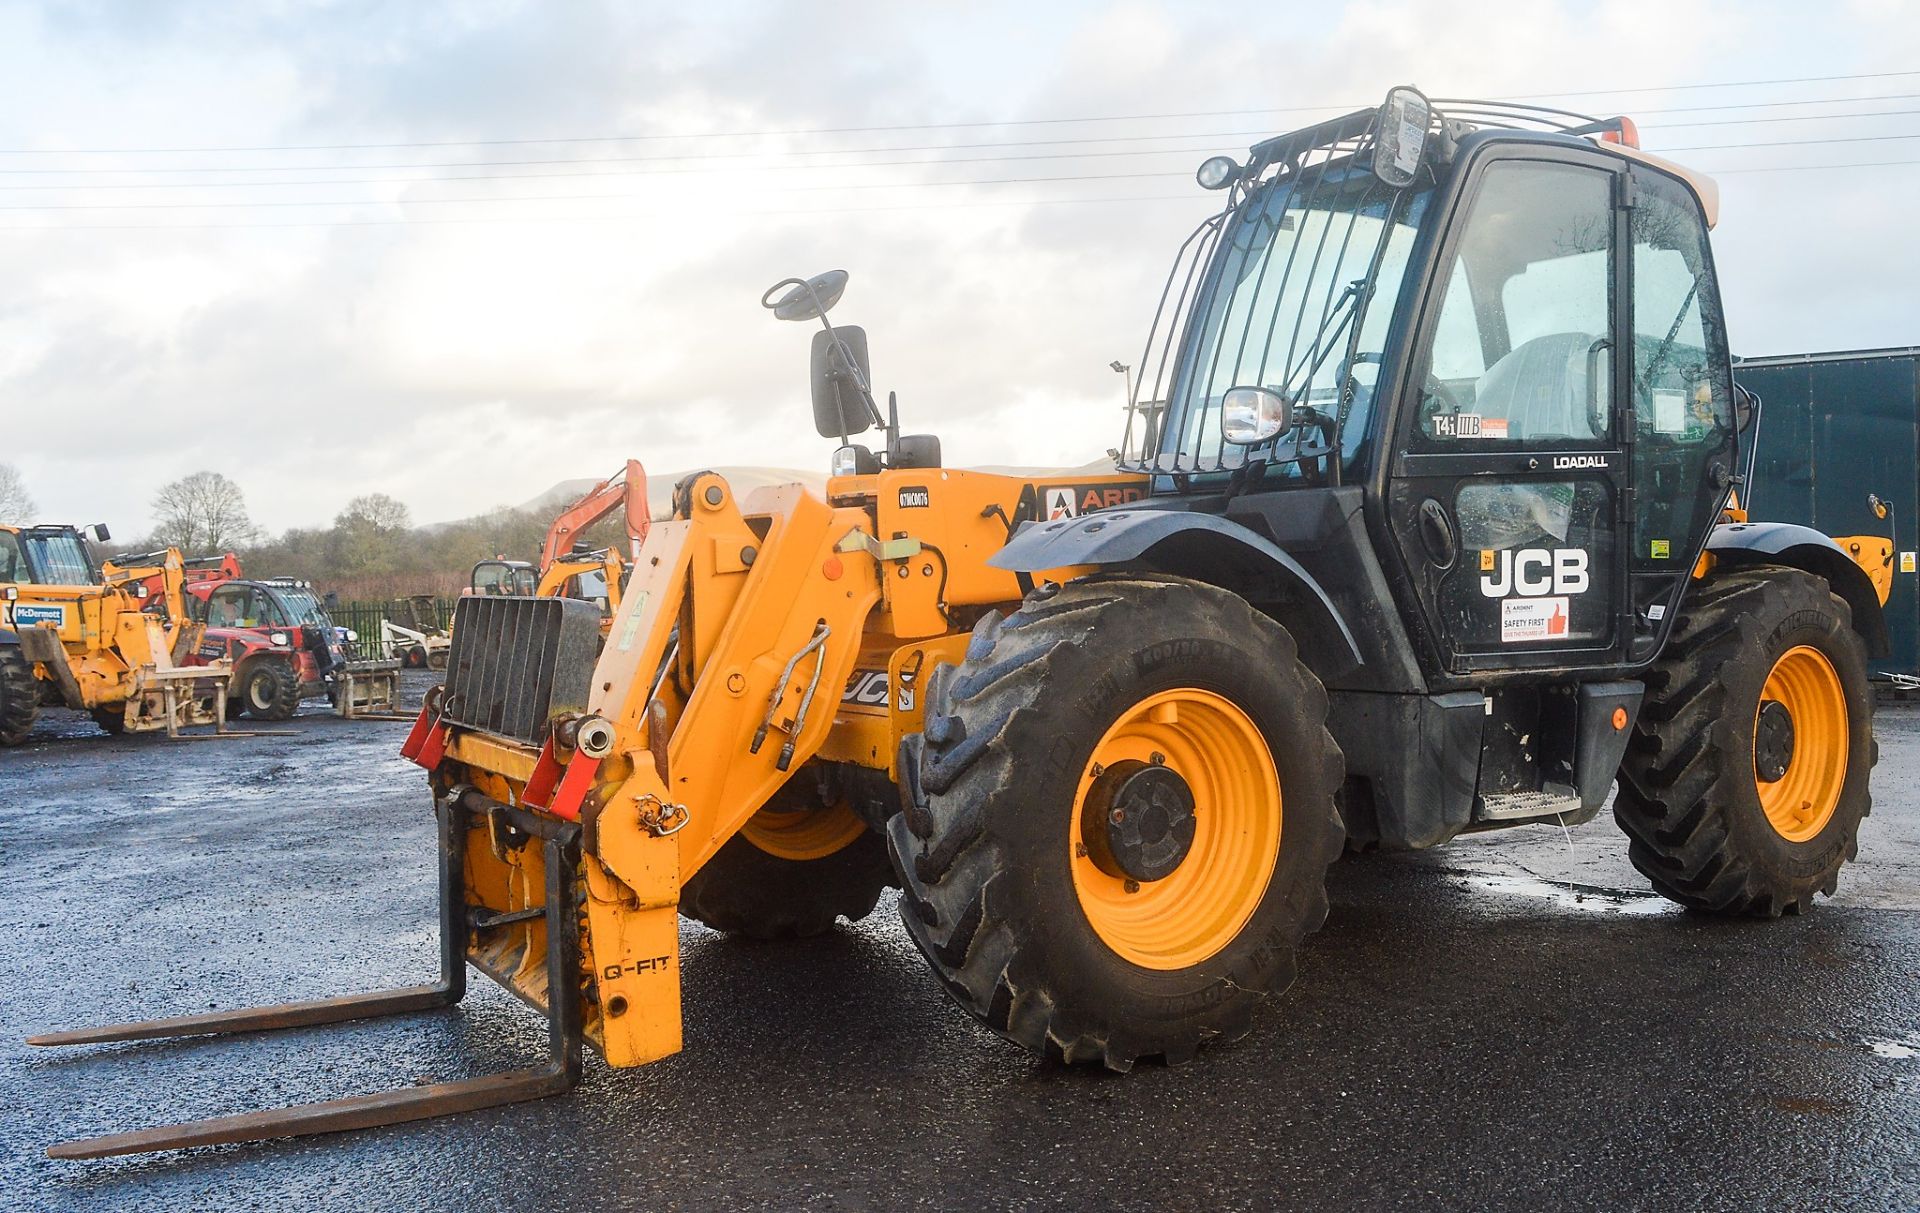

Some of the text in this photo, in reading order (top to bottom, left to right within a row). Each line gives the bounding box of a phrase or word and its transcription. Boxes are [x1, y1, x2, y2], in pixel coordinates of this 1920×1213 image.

[1432, 415, 1456, 436] T4i
[1553, 455, 1609, 469] LOADALL
[1081, 488, 1151, 509] ARD
[1481, 549, 1589, 598] JCB
[17, 608, 60, 619] McDermott
[1504, 618, 1545, 628] SAFETY FIRST
[841, 672, 889, 704] JC
[604, 955, 670, 980] Q-FIT
